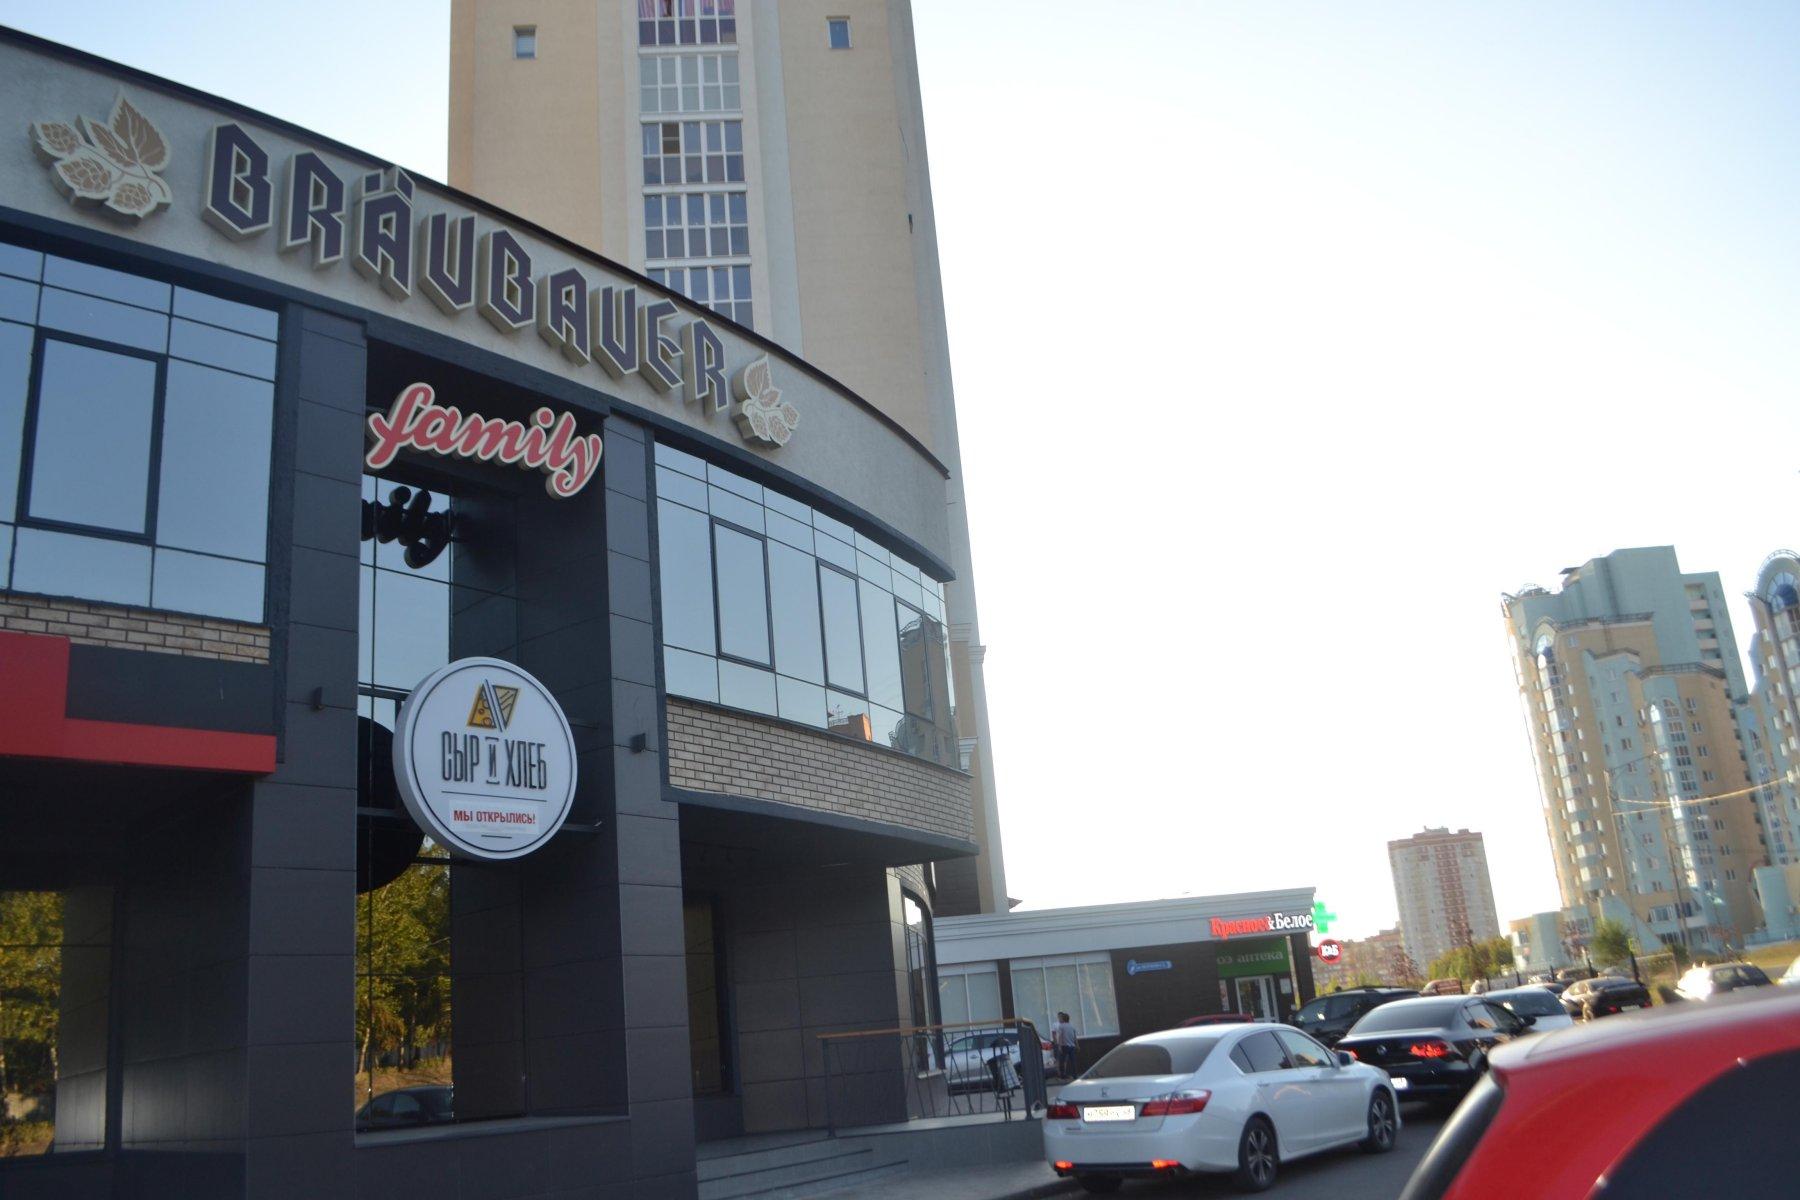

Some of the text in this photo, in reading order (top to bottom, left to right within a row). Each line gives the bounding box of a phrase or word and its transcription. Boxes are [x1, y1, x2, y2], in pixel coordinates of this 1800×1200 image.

[203, 121, 731, 414] BRÄUBAUER
[365, 382, 603, 498] family
[442, 731, 480, 783] СЫР
[505, 738, 547, 790] ХЛЕБ
[453, 809, 536, 825] МЫ ОТКРЫЛИСЬ!
